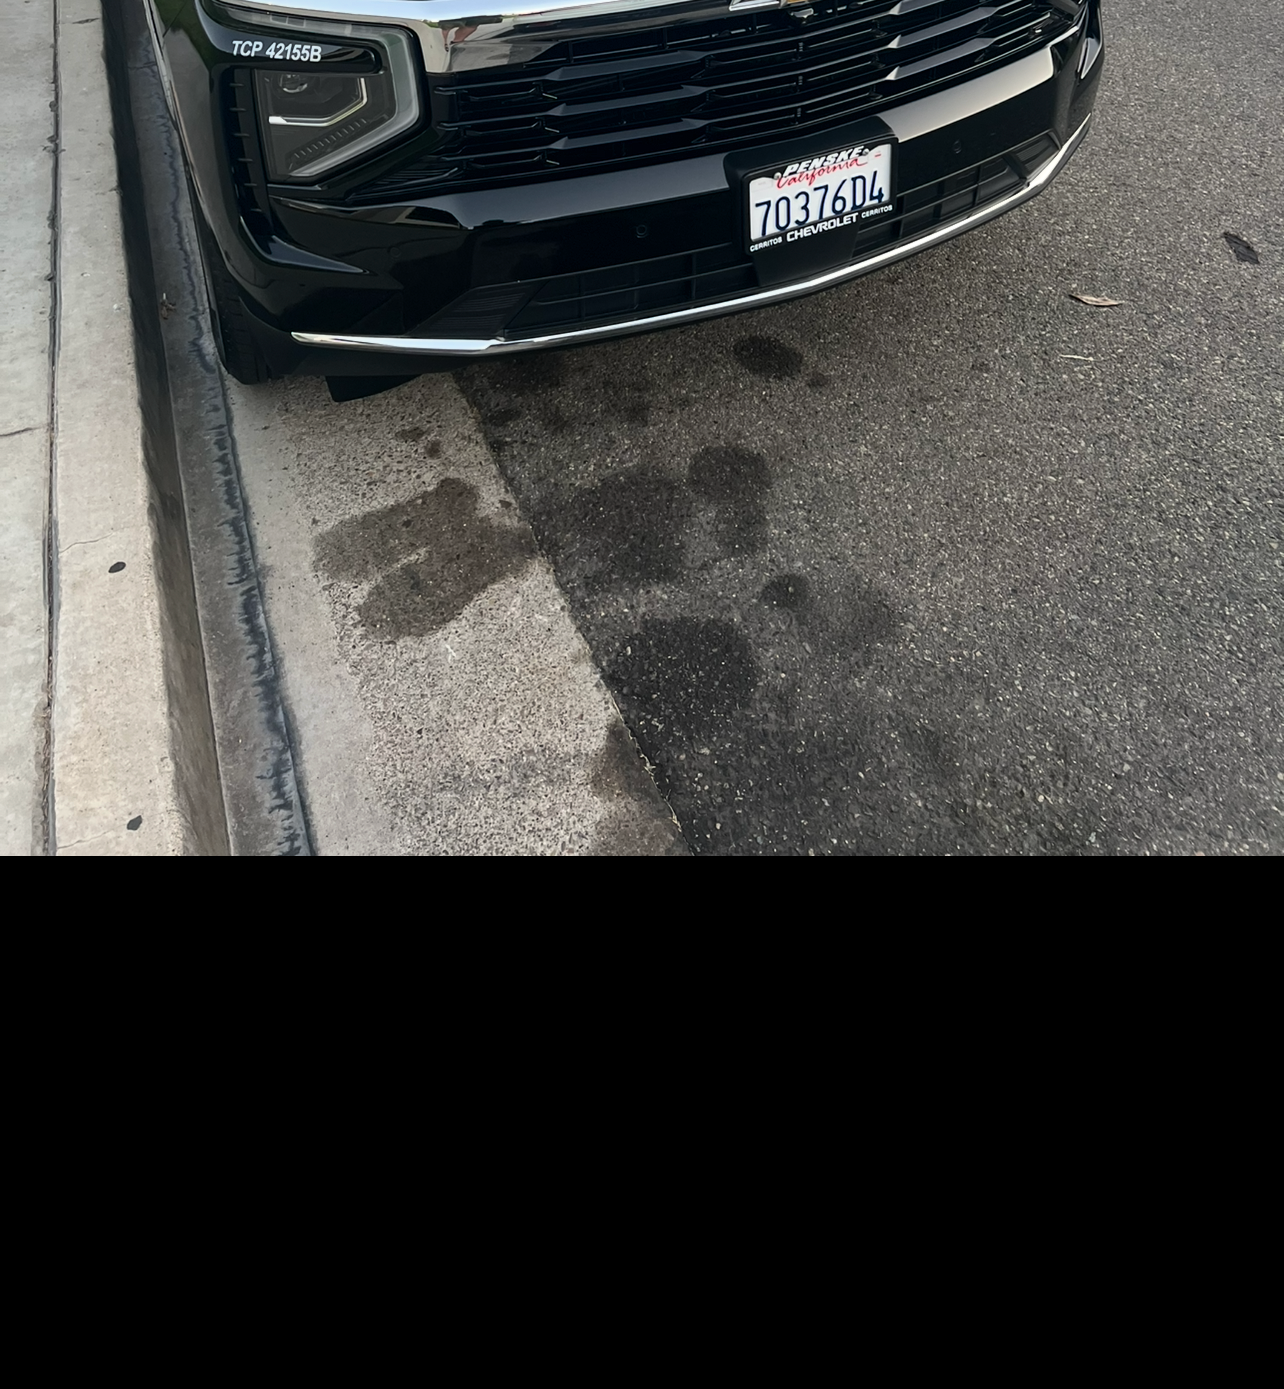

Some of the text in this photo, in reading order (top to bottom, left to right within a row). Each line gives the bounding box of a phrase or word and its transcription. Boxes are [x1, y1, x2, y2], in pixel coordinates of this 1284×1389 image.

[232, 40, 322, 62] TCP 42155B
[776, 157, 868, 189] California
[782, 145, 865, 177] PENSKE
[755, 170, 884, 237] 70376D4
[750, 204, 893, 252] CERRITOS CHEVROLET CERRITOS
